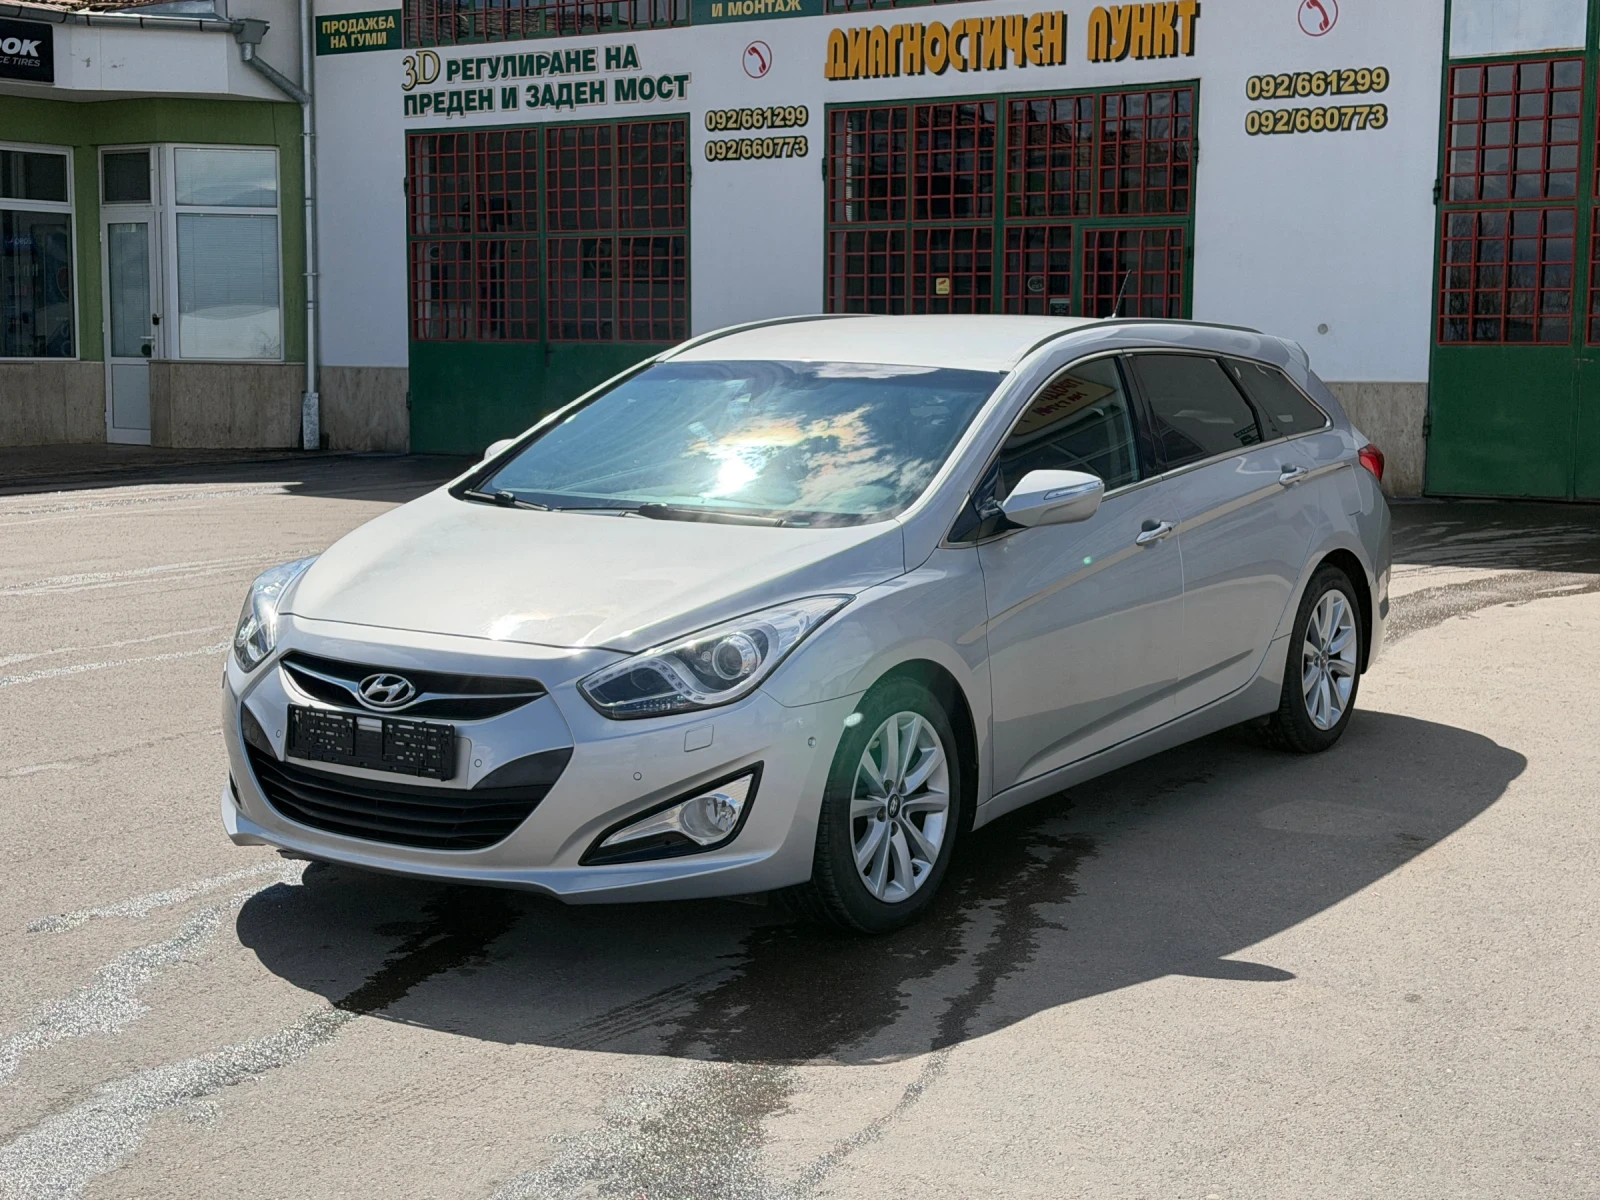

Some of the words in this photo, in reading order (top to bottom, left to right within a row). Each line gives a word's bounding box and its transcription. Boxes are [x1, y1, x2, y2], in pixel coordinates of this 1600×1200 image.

[711, 3, 723, 18] И
[727, 0, 802, 17] МОНТАЖ
[322, 15, 396, 35] ПРОДАЖБА
[0, 37, 43, 57] OK
[330, 35, 348, 49] НА
[351, 31, 387, 47] ГУМИ
[824, 10, 1066, 80] ДИАГНОСТИЧЕН
[1087, 0, 1199, 62] ПУНКТ
[12, 56, 41, 67] TIRES
[402, 50, 441, 91] 3D
[446, 48, 597, 82] РЕГУЛИРАНЕ
[605, 44, 640, 71] НА
[404, 87, 494, 118] ПРЕДЕН
[501, 86, 519, 111] И
[525, 79, 606, 110] ЗАДЕН
[614, 73, 691, 104] МОСТ
[1246, 66, 1389, 100] 092/661299
[705, 106, 808, 132] 092/661299
[1245, 104, 1387, 135] 092/660773
[705, 136, 808, 161] 092/660773
